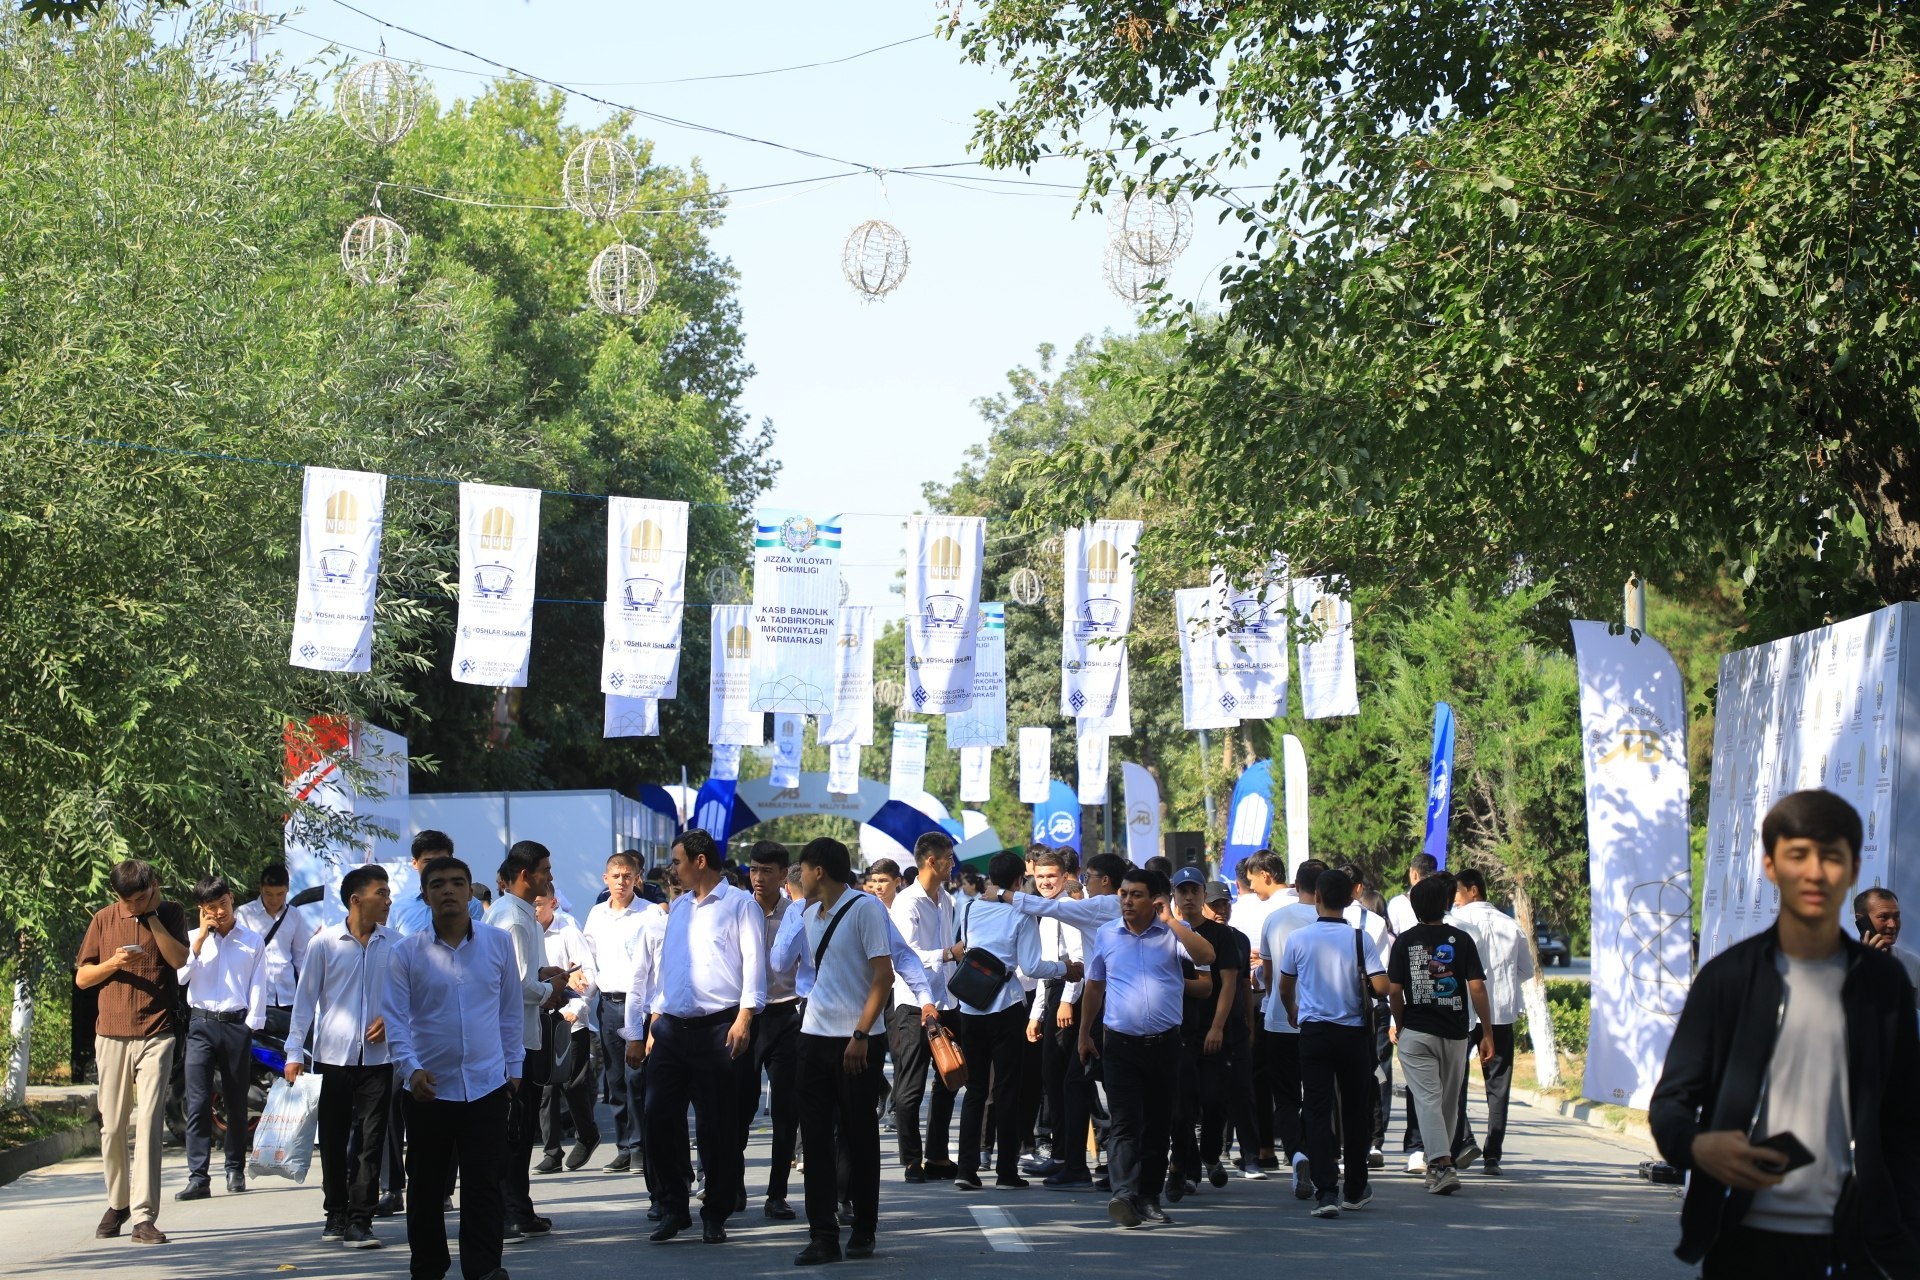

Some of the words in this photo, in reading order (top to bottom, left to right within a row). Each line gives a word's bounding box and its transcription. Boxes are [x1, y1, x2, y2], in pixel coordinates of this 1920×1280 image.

[796, 557, 832, 566] VILOYATI
[776, 566, 819, 574] HOKIMLIGI
[931, 566, 960, 577] NBU
[1089, 568, 1118, 579] NBU
[316, 611, 344, 620] YOSHLAR
[762, 606, 786, 614] KASB
[790, 608, 828, 616] BANDLIK
[770, 616, 834, 626] TADBIRKORLIK
[761, 626, 828, 635] IMKONIYATLARI
[766, 635, 822, 644] YARMARKASI
[727, 648, 751, 657] NBU
